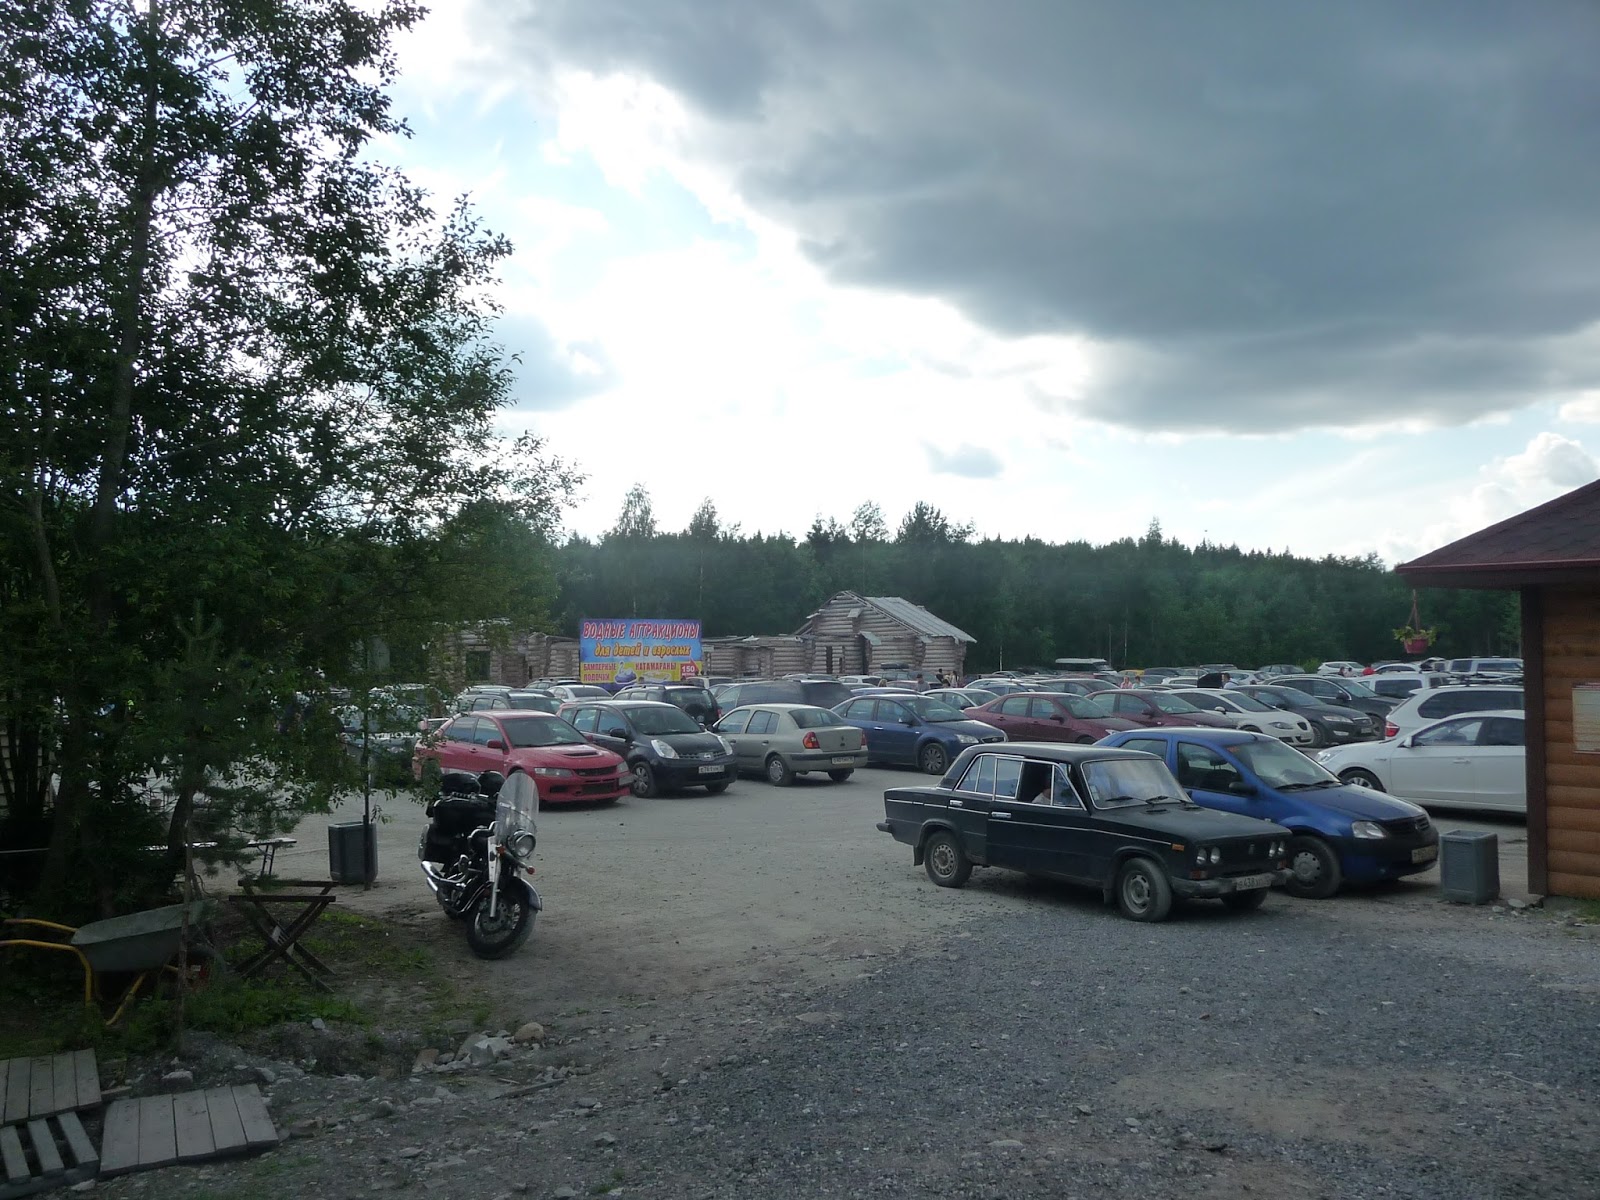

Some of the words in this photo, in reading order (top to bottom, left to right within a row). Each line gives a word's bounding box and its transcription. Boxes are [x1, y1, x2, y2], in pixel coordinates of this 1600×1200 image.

[583, 622, 626, 640] ВОДНЫЕ
[630, 623, 699, 641] АТТРАКЦИОНЫ
[594, 642, 610, 657] для
[613, 642, 642, 657] детей
[643, 647, 650, 657] и
[652, 646, 691, 658] взрослых
[583, 663, 616, 671] БАМПЕРНЫЕ
[635, 662, 677, 671] КАТАМАРАНЫ
[682, 665, 695, 673] 150
